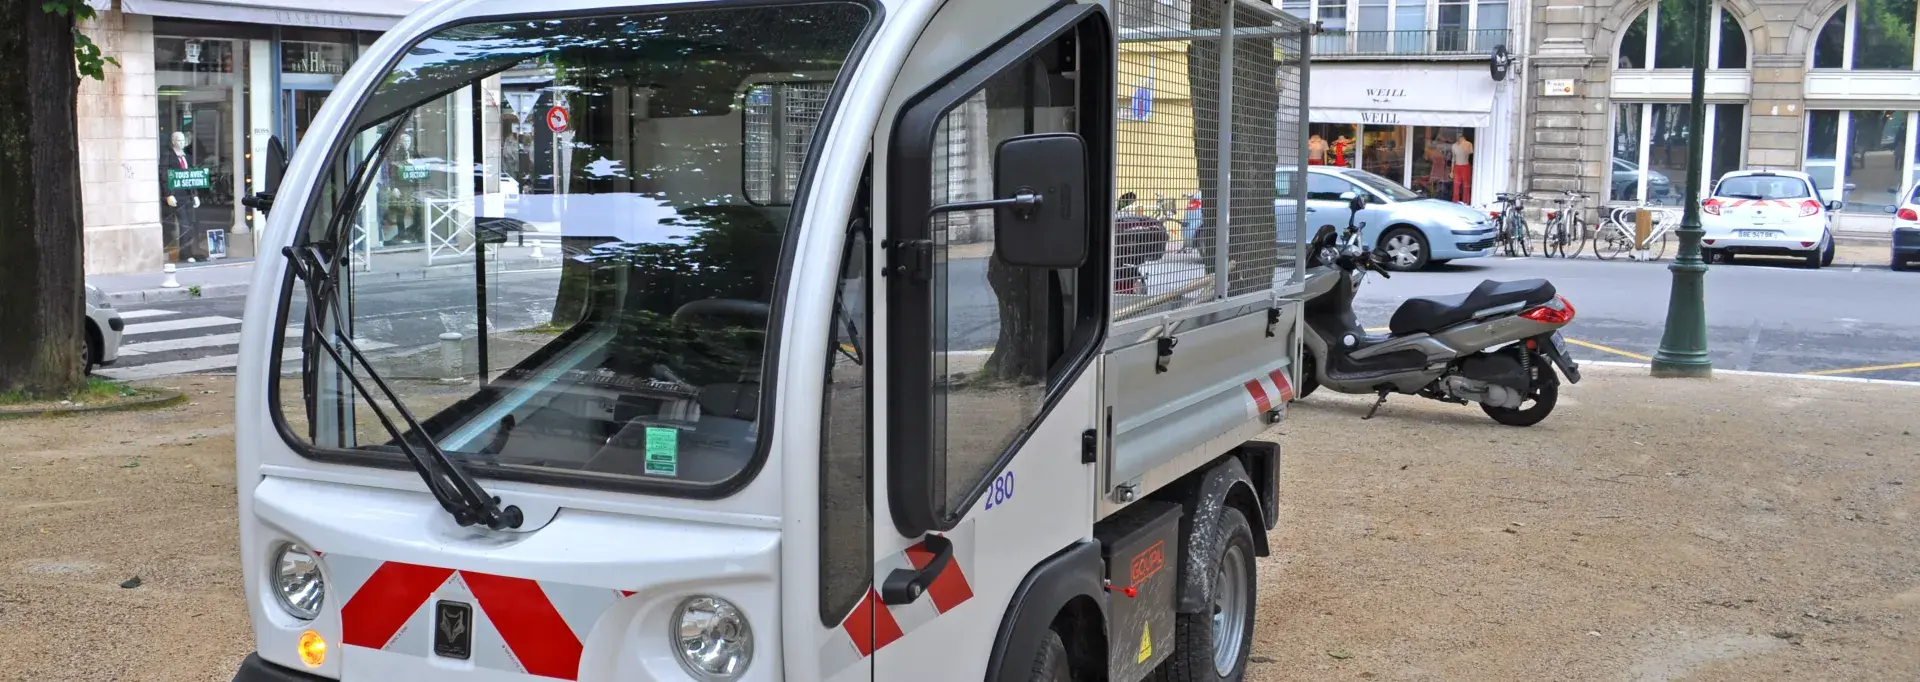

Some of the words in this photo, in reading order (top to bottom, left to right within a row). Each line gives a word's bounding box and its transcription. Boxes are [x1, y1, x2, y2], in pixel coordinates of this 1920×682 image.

[1366, 88, 1407, 97] WEILL
[1361, 112, 1400, 124] WEILL
[175, 171, 189, 179] TOUS
[190, 170, 204, 178] AVEC
[174, 179, 181, 187] LA
[182, 178, 203, 187] SECTION
[985, 471, 1014, 511] 280
